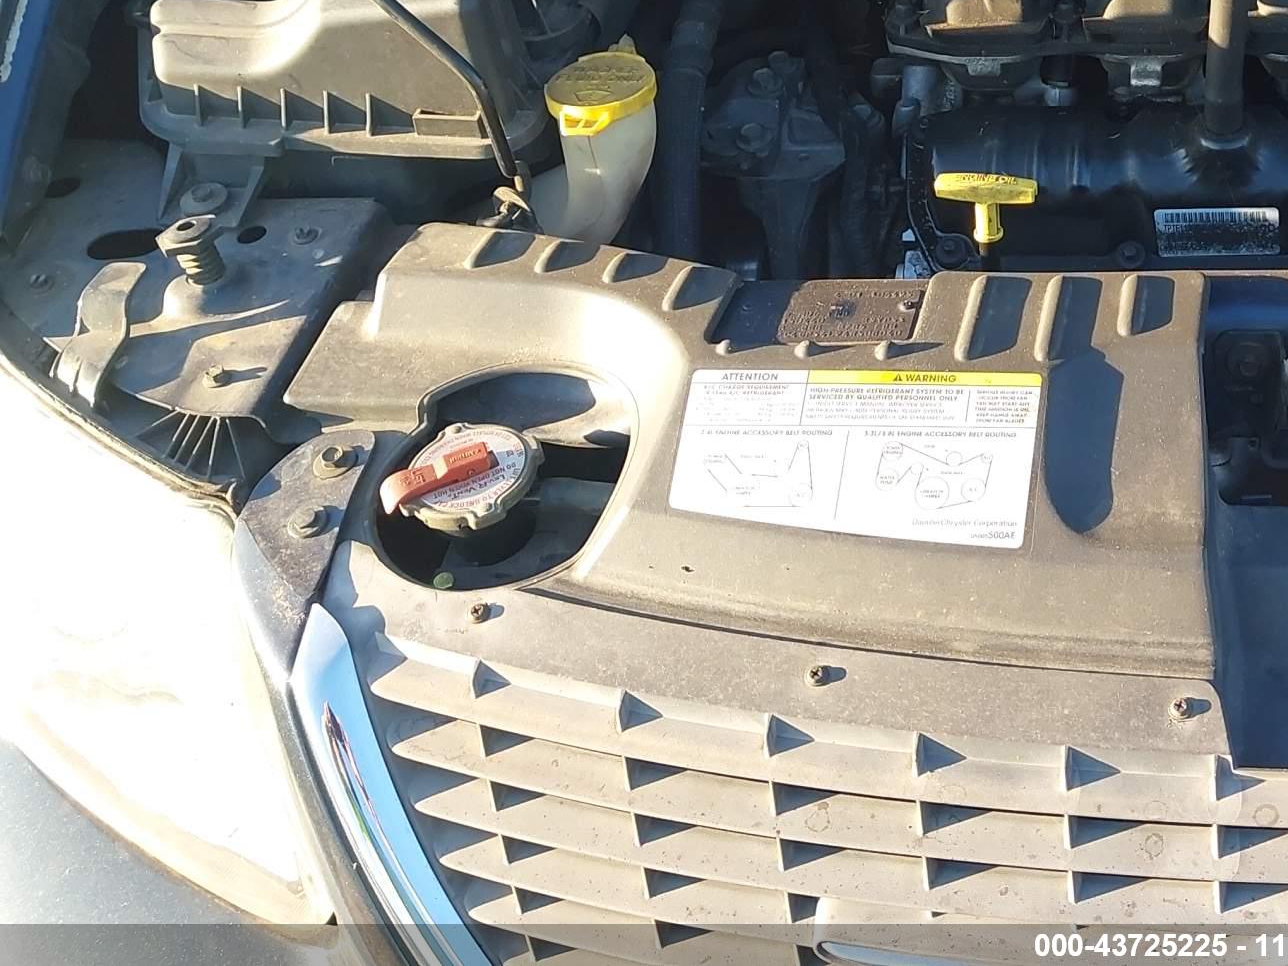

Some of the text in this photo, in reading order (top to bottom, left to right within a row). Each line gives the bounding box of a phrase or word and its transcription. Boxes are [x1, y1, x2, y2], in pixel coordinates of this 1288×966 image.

[556, 74, 644, 83] FLUID ONLY
[956, 174, 1018, 185] ENGINE OIL
[721, 372, 779, 381] ATTENTION
[905, 374, 958, 383] WARNING
[856, 394, 893, 402] QUALIFIED
[491, 465, 506, 476] NOT
[506, 462, 516, 470] DO
[471, 471, 490, 483] OPEN
[432, 489, 448, 499] HOT
